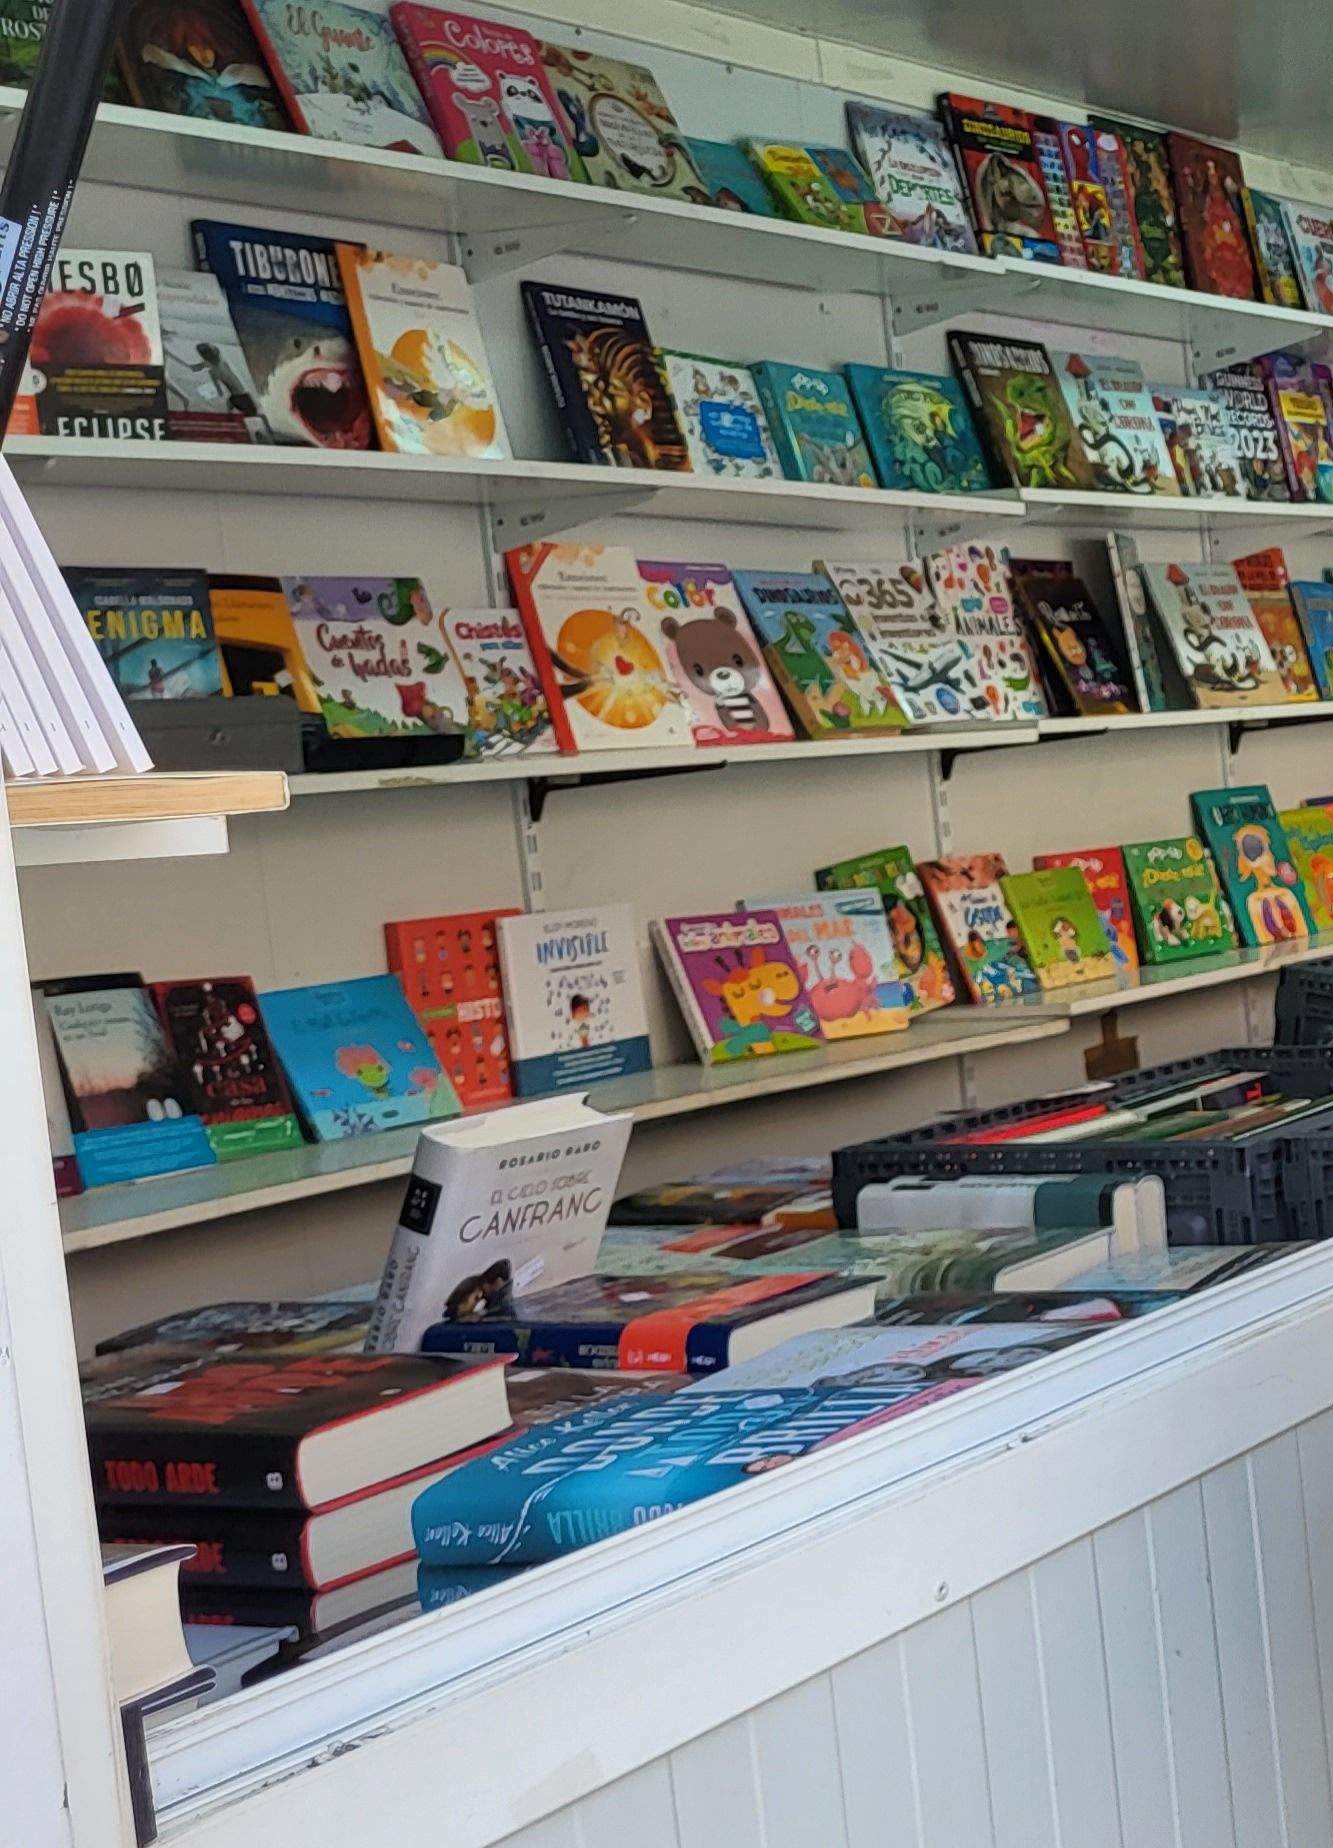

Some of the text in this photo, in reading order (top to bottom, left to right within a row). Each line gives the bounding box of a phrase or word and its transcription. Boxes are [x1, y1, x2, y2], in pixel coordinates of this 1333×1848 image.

[444, 19, 535, 66] Colores
[39, 201, 60, 247] PRESSURE
[12, 258, 28, 282] ALTA
[25, 269, 40, 295] OPEN
[16, 314, 28, 327] DO
[20, 295, 33, 314] NOT
[1231, 428, 1279, 461] 2023
[86, 609, 208, 641] ENIGMA
[536, 931, 610, 965] INVISIBLE
[459, 1186, 604, 1244] CANFRANC
[106, 1460, 220, 1494] TODO ARDE
